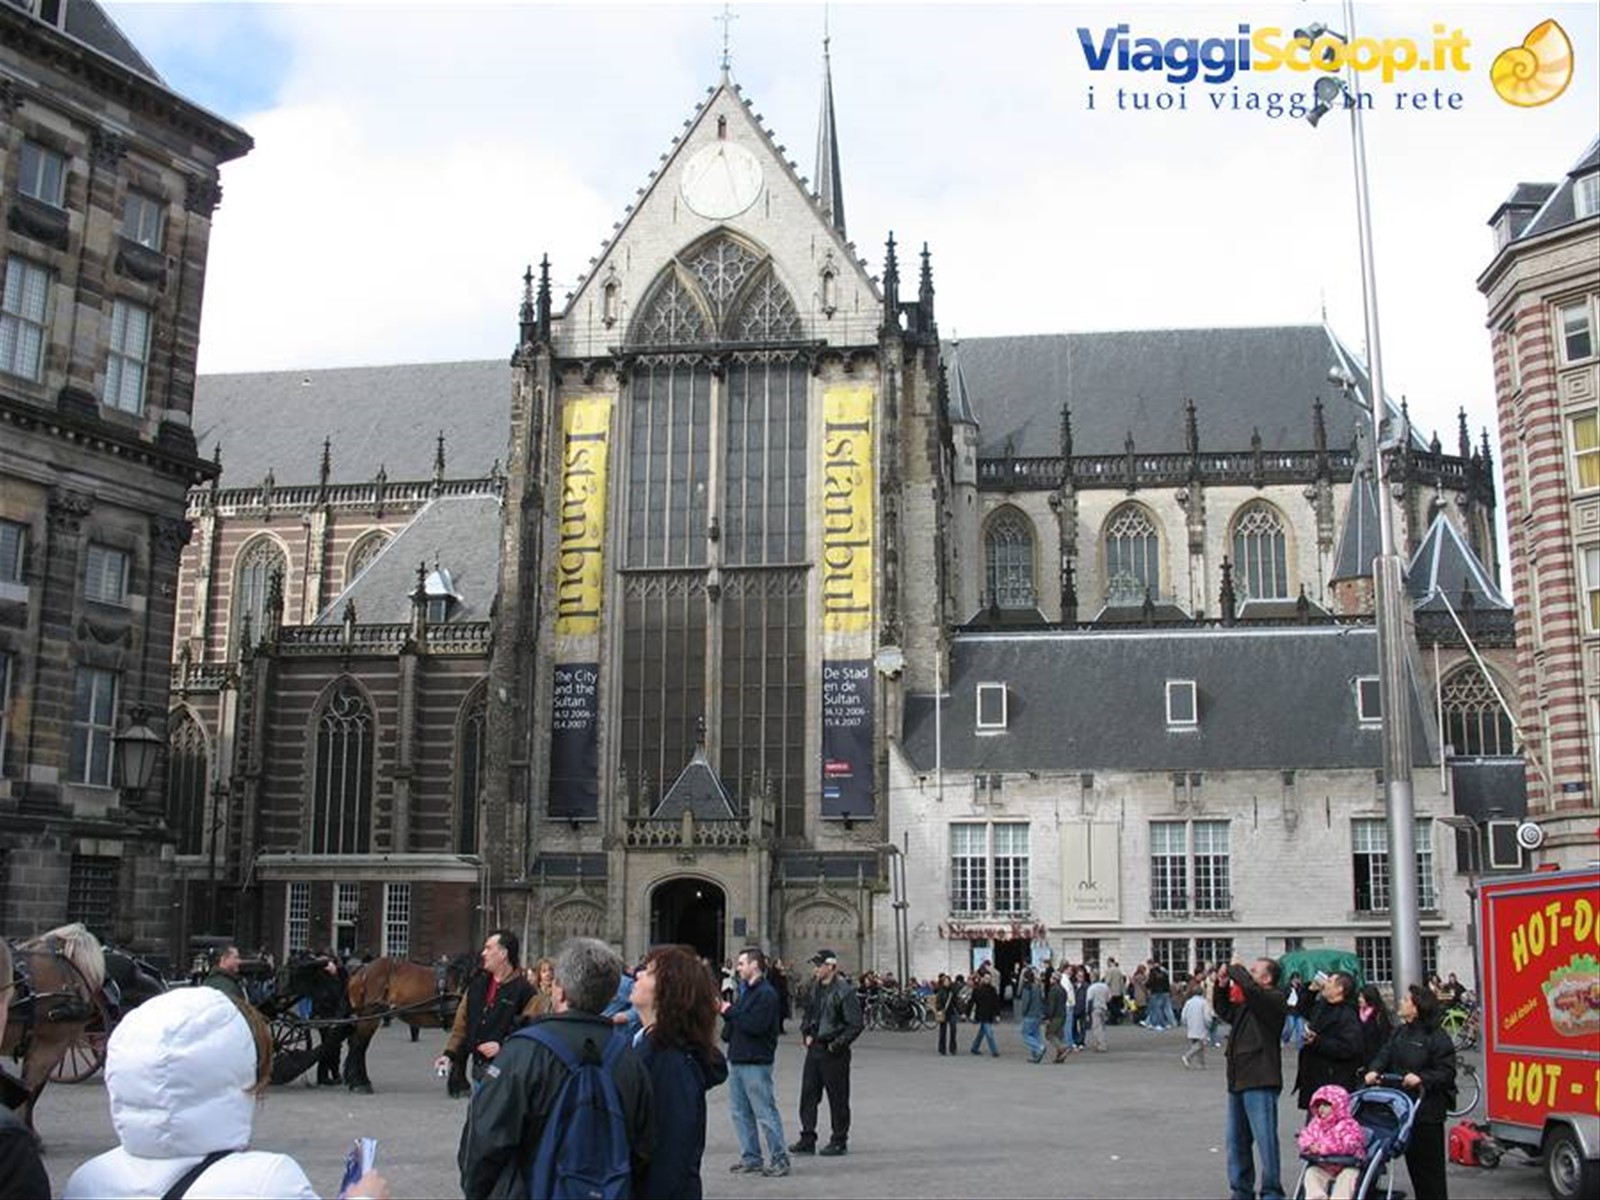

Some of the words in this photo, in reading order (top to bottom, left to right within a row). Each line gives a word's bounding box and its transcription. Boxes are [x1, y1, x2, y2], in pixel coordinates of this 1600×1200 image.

[824, 420, 870, 614] Istanbul
[559, 432, 607, 618] Istanbul
[575, 670, 597, 684] City
[824, 667, 840, 680] De
[842, 667, 868, 680] Stad
[576, 683, 595, 695] the
[824, 682, 838, 692] en
[841, 679, 857, 692] de
[554, 695, 586, 708] Sultan
[824, 693, 860, 705] Sultan
[1506, 1061, 1562, 1108] HOT
